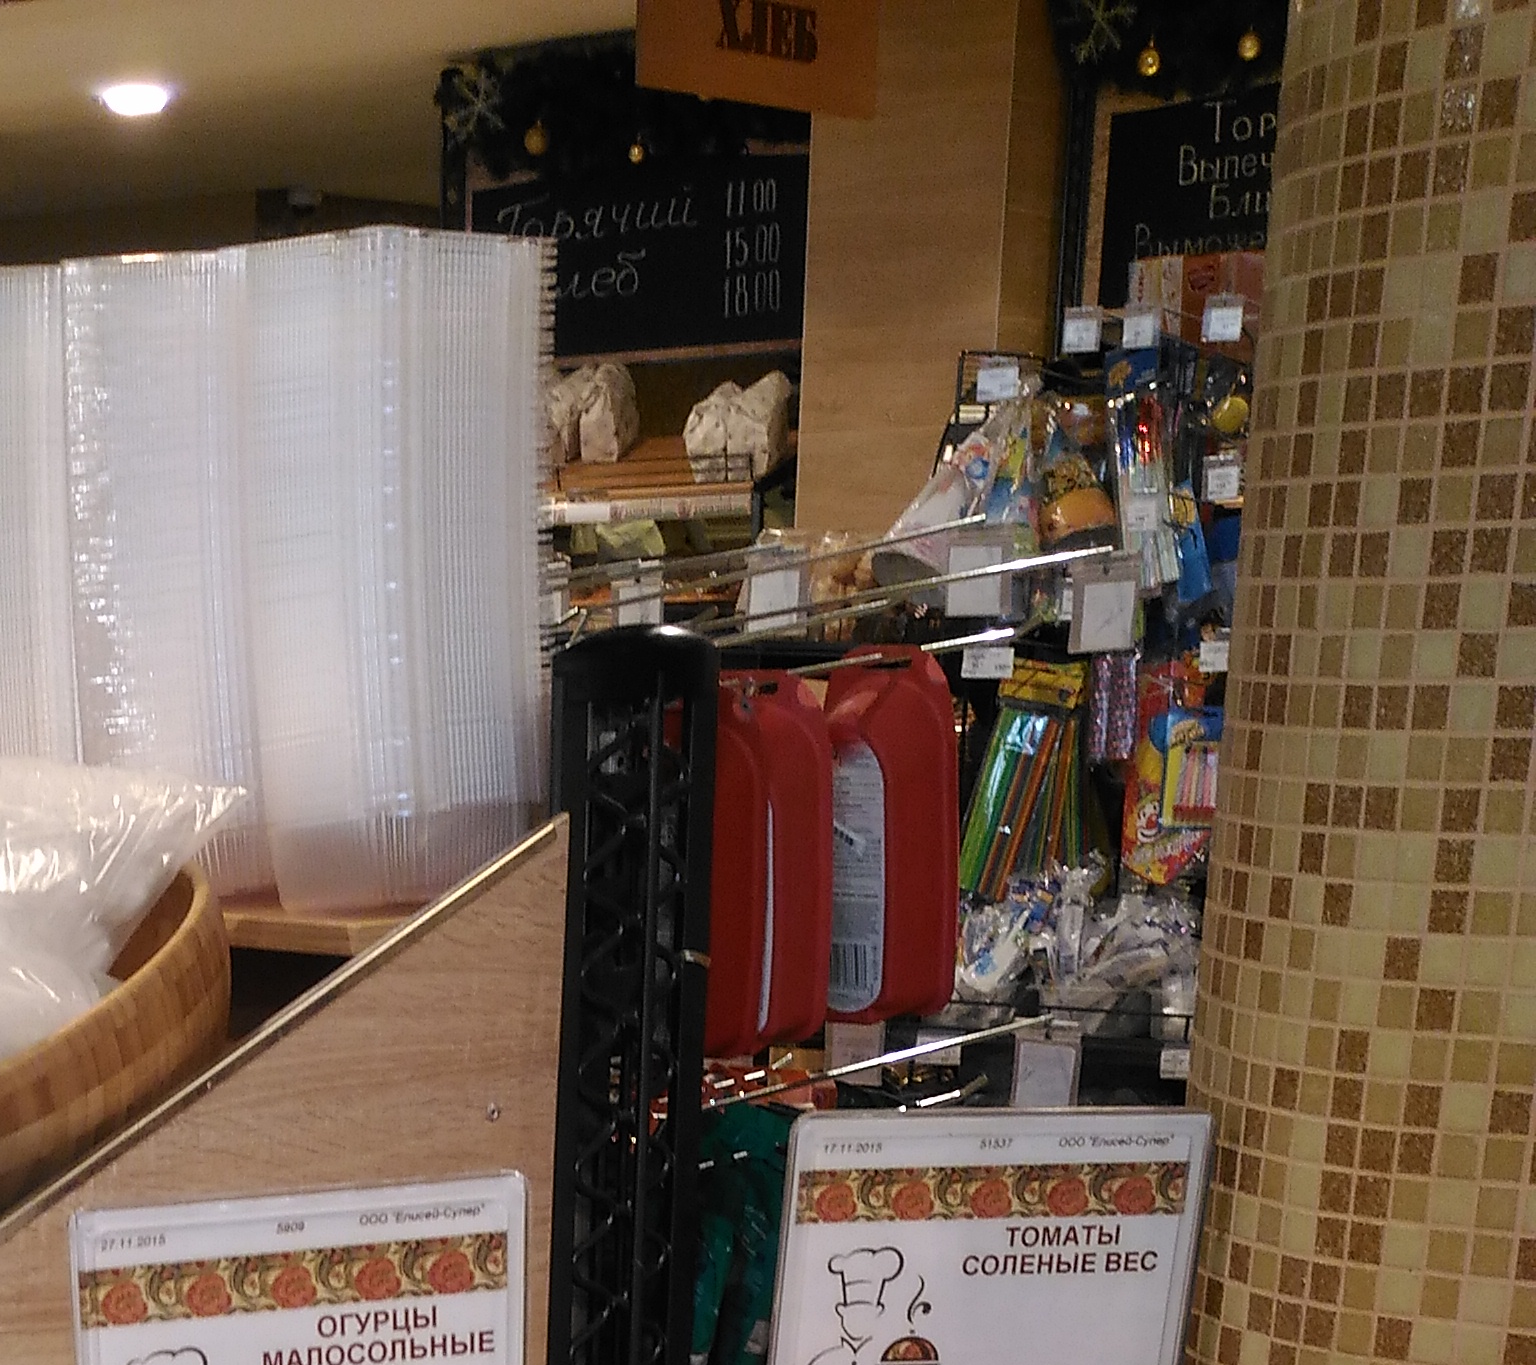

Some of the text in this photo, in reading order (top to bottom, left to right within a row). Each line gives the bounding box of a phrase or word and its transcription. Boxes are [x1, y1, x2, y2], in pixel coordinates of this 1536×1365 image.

[715, 0, 818, 63] ХЛЕБ
[556, 249, 646, 299] леб
[359, 1213, 389, 1227] ООО
[1005, 1224, 1121, 1249] ТОМАТЫ
[962, 1250, 1159, 1277] СОЛЕНЫЕ ВЕС
[317, 1305, 439, 1339] ОГУРЦЫ
